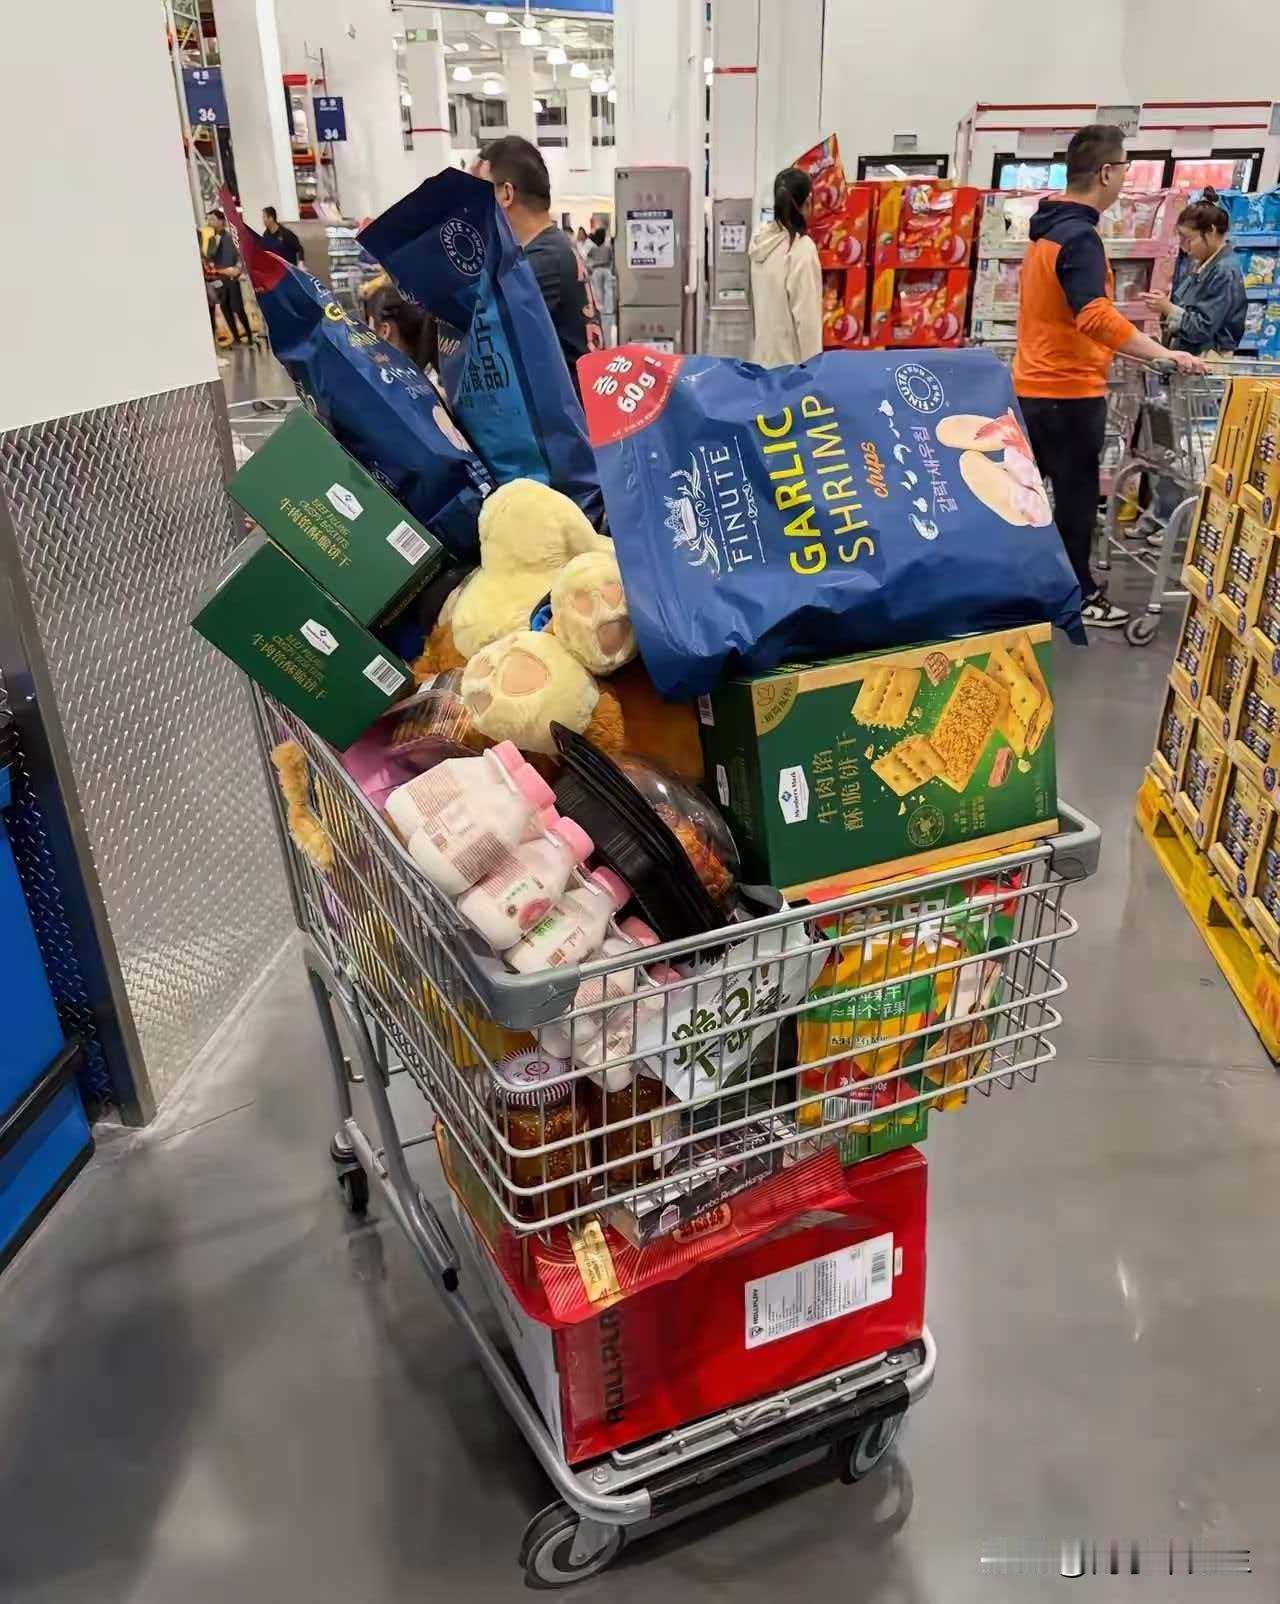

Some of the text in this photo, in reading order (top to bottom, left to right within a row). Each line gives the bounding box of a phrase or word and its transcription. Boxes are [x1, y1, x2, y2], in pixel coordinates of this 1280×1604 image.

[198, 108, 216, 122] 36
[324, 128, 339, 140] 34
[709, 445, 753, 564] FINUTE
[756, 407, 828, 576] GARLIC
[801, 395, 876, 563] SHRIMP
[860, 441, 889, 498] chips
[812, 749, 838, 824] 牛肉馅
[836, 731, 865, 833] 酥脆饼干
